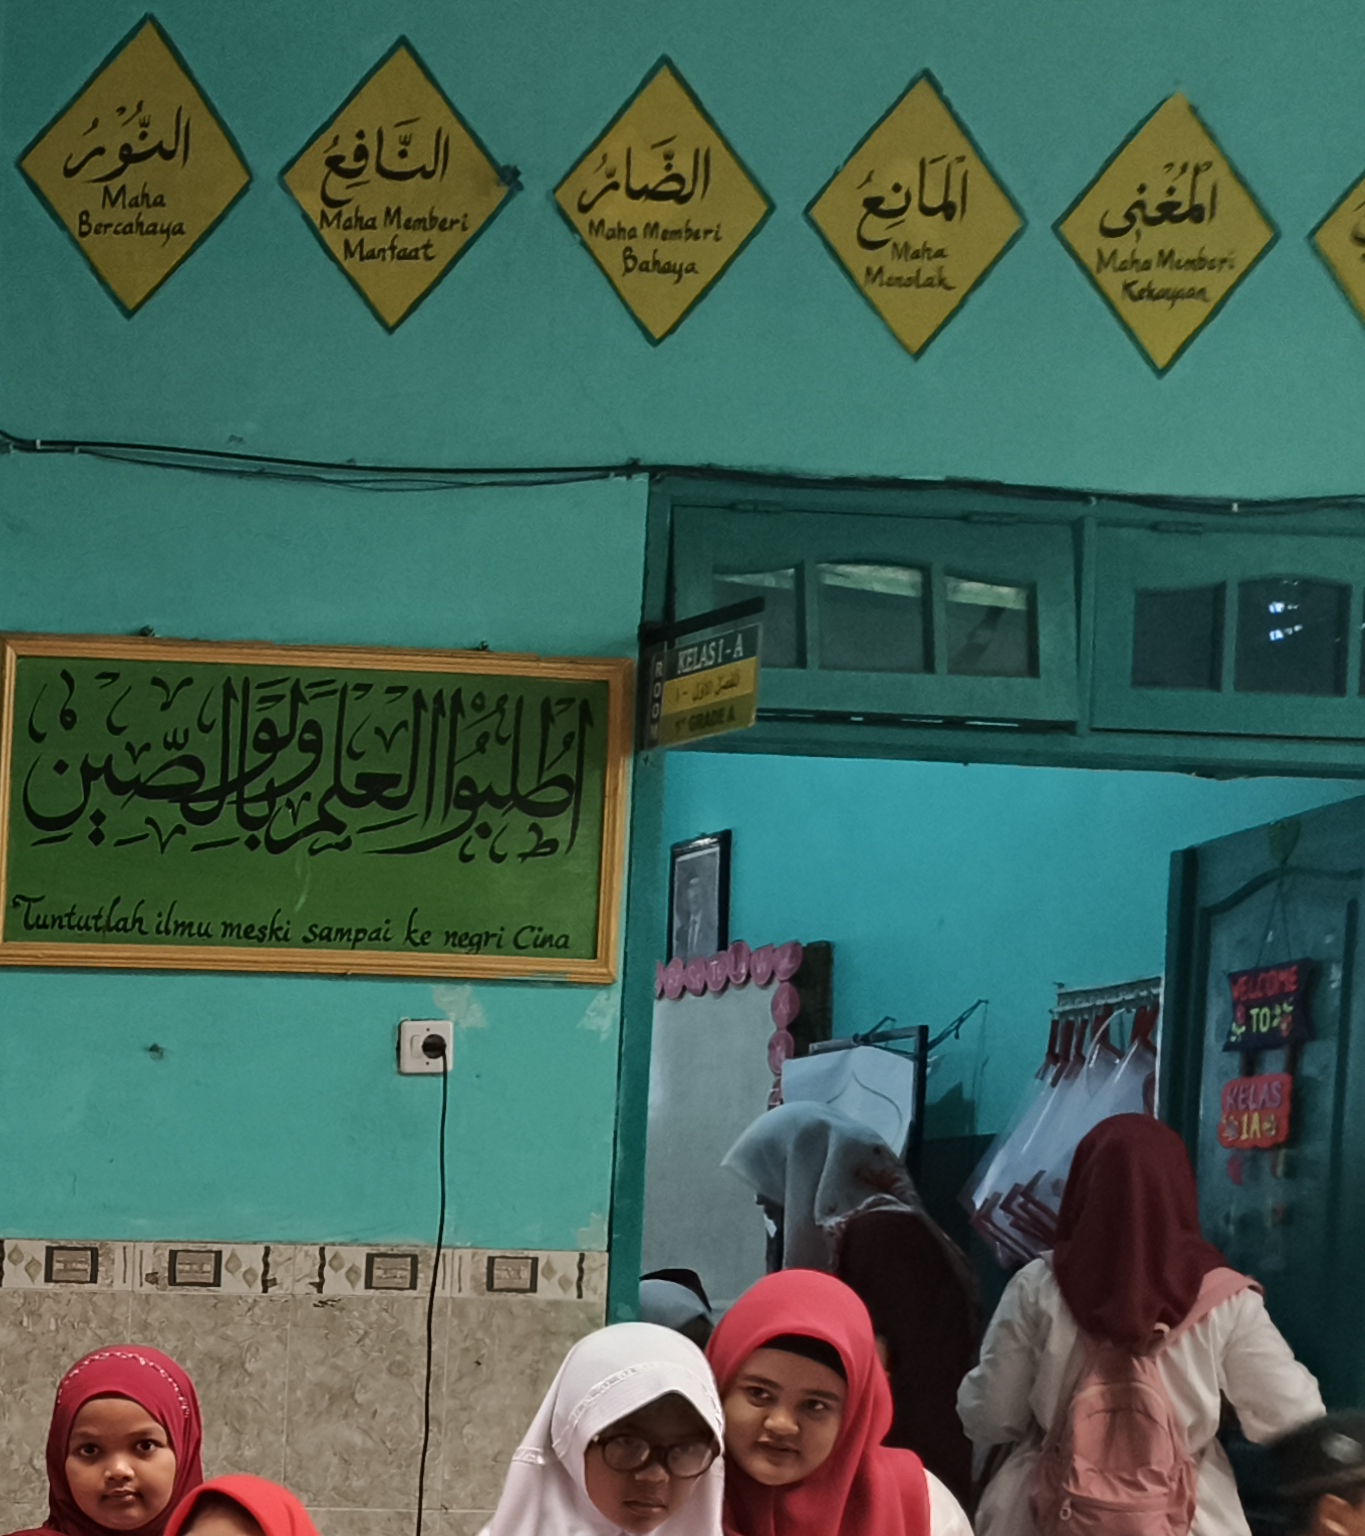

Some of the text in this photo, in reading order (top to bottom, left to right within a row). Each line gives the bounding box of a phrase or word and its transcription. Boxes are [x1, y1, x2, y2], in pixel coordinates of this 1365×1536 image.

[101, 182, 166, 209] Maha
[78, 209, 185, 247] Bercahaya
[320, 205, 469, 232] Maha Memberi
[588, 219, 722, 242] Maha Memberi
[343, 234, 436, 263] Manfaat
[891, 241, 948, 262] Maha
[1096, 246, 1236, 274] Maha Memberi
[622, 246, 699, 285] Bahaya
[864, 265, 957, 290] Menolak
[677, 641, 716, 675] KELAS
[12, 895, 570, 955] Tuntutlah ilmu meski sampai ke negri Cina
[1249, 1006, 1270, 1033] TO
[1226, 1081, 1282, 1111] KELAS
